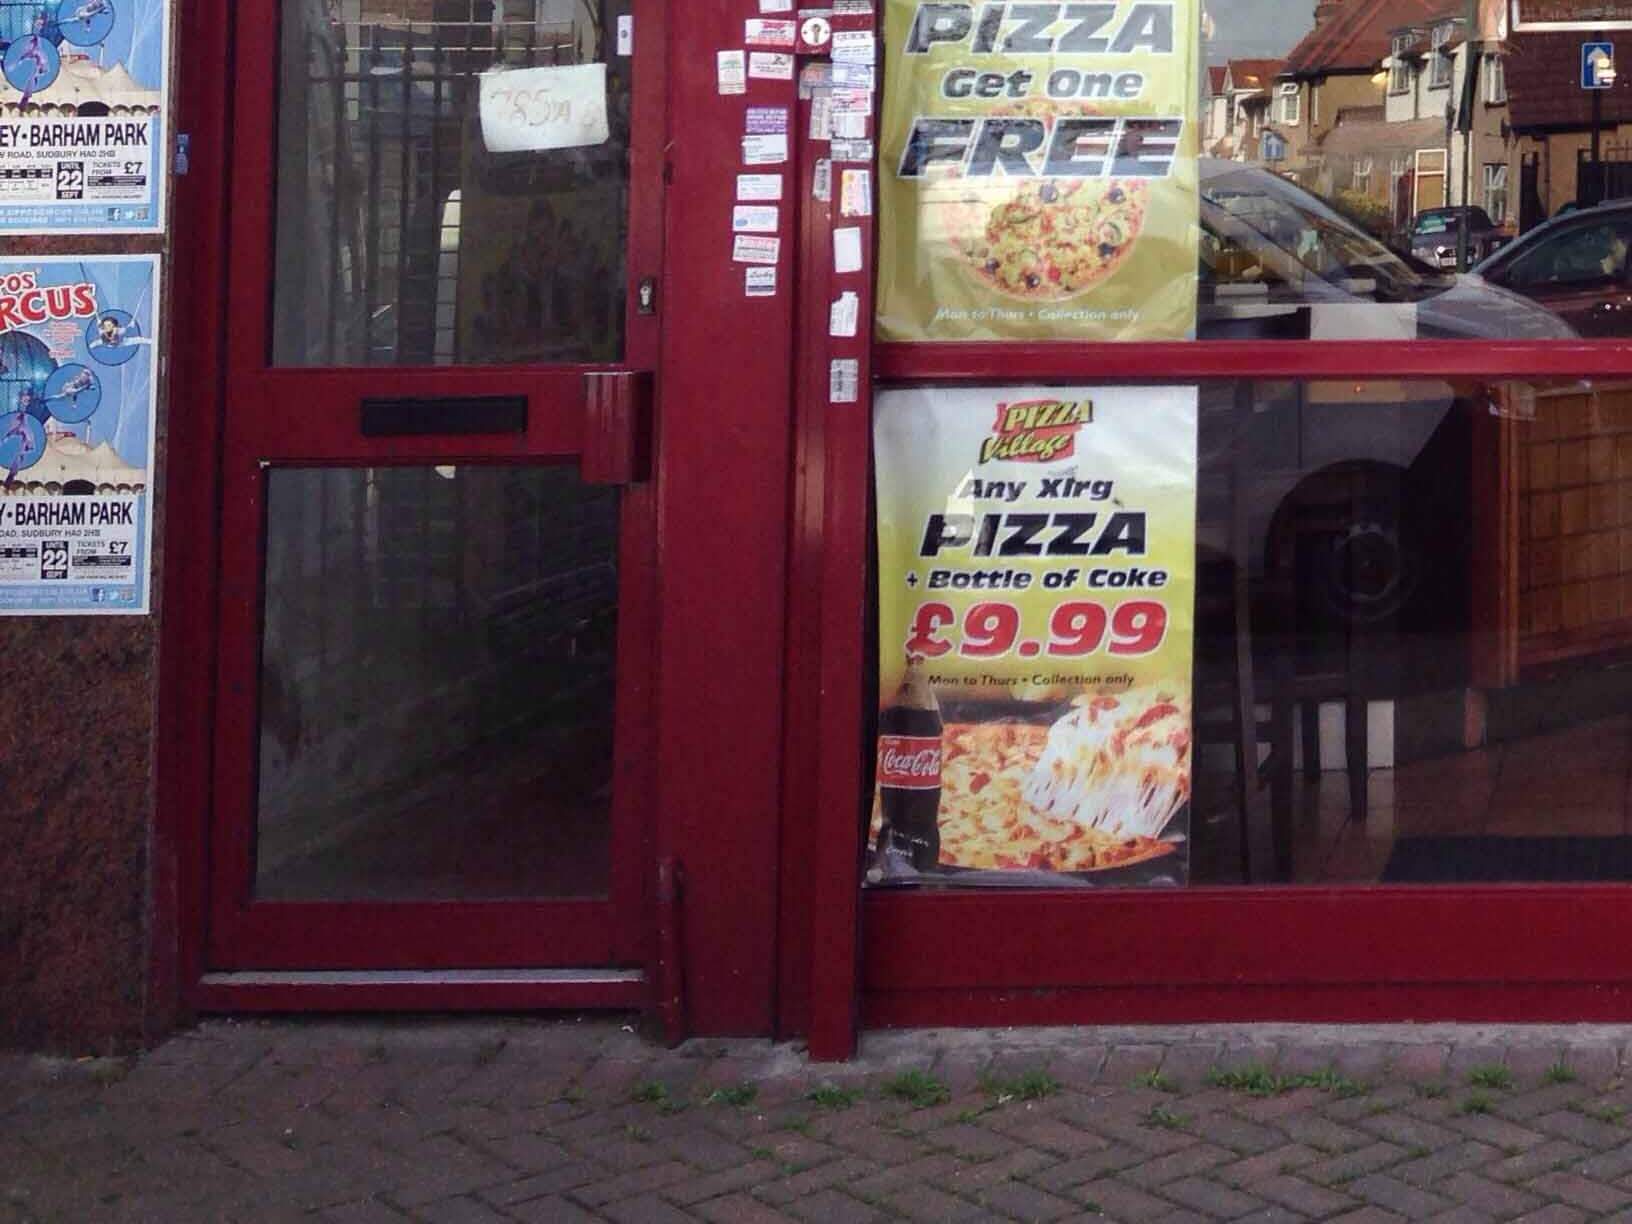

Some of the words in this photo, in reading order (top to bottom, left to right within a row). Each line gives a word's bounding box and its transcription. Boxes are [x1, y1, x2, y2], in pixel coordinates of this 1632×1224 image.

[904, 1, 1176, 55] PIZZA
[941, 69, 1033, 98] Get
[1047, 68, 1144, 99] One
[30, 123, 100, 147] BARHAM
[105, 122, 148, 146] PARK
[897, 116, 1184, 178] FREE
[57, 170, 82, 191] 22
[124, 161, 143, 175] £7
[1037, 308, 1107, 321] Collection
[1109, 309, 1139, 325] only
[1002, 400, 1093, 433] PIZZA
[978, 433, 1074, 464] Village
[961, 478, 1027, 502] Any
[15, 502, 85, 526] BARHAM
[90, 501, 133, 525] PARK
[918, 511, 1149, 557] PIZZA
[109, 541, 128, 554] £7
[42, 550, 67, 571] 22
[928, 569, 1031, 589] Bottle
[1042, 568, 1081, 589] of
[1087, 567, 1169, 589] Coke
[905, 600, 1170, 657] £9.99
[928, 675, 959, 686] Mon
[963, 675, 977, 686] to
[981, 675, 1018, 686] Thurs
[1031, 674, 1101, 686] Collection
[1104, 674, 1135, 688] only
